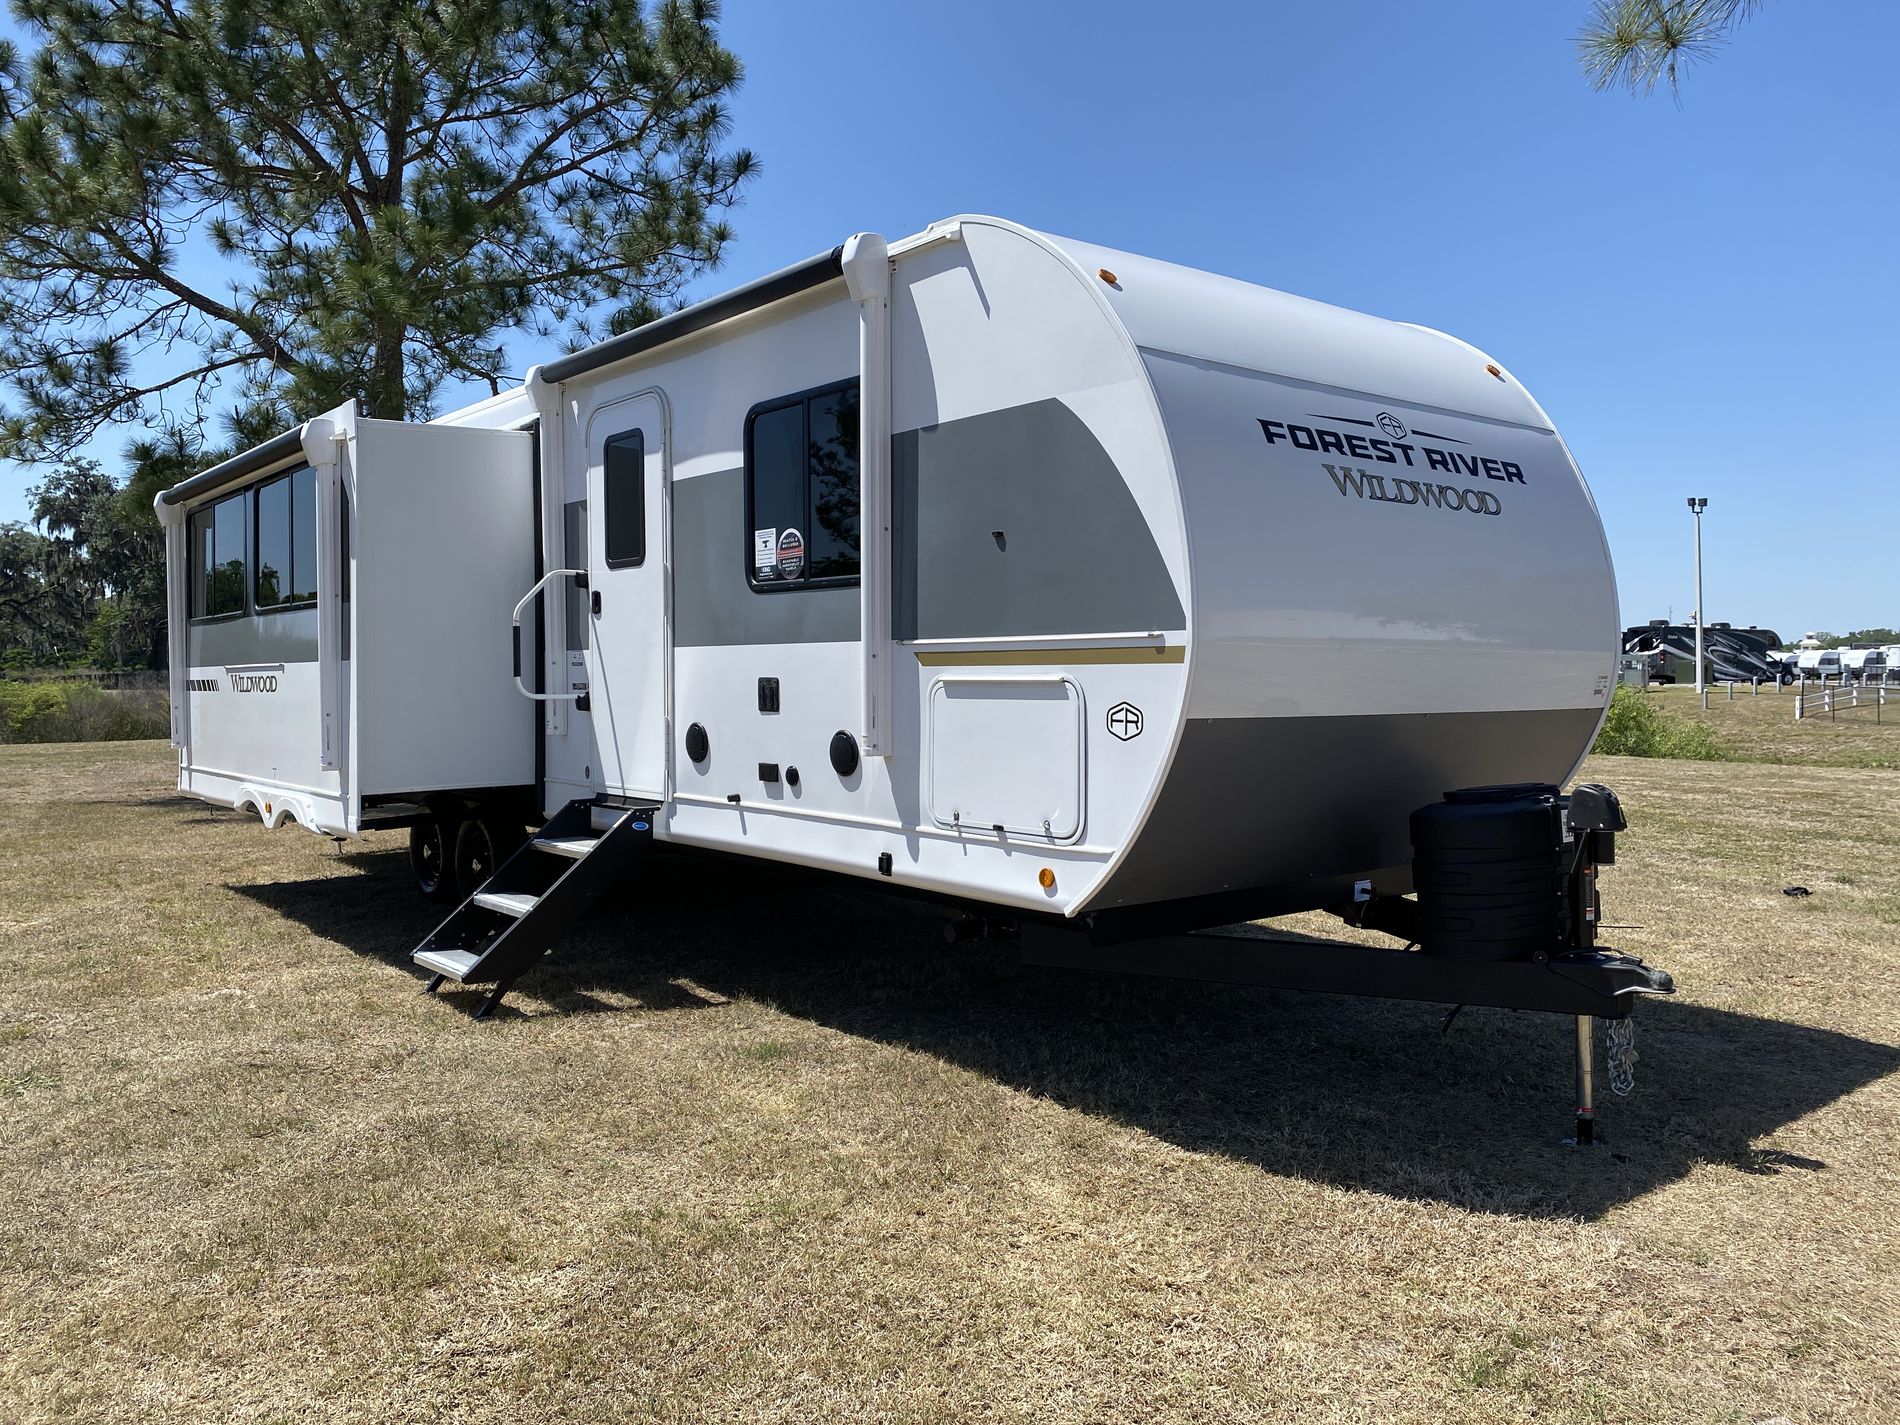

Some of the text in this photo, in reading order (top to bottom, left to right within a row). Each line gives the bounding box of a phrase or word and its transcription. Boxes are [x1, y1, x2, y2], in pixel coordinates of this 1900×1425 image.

[1256, 418, 1527, 485] FOREST RIVER
[1322, 463, 1502, 516] WILDWOOD
[230, 674, 278, 693] WILDWOOD
